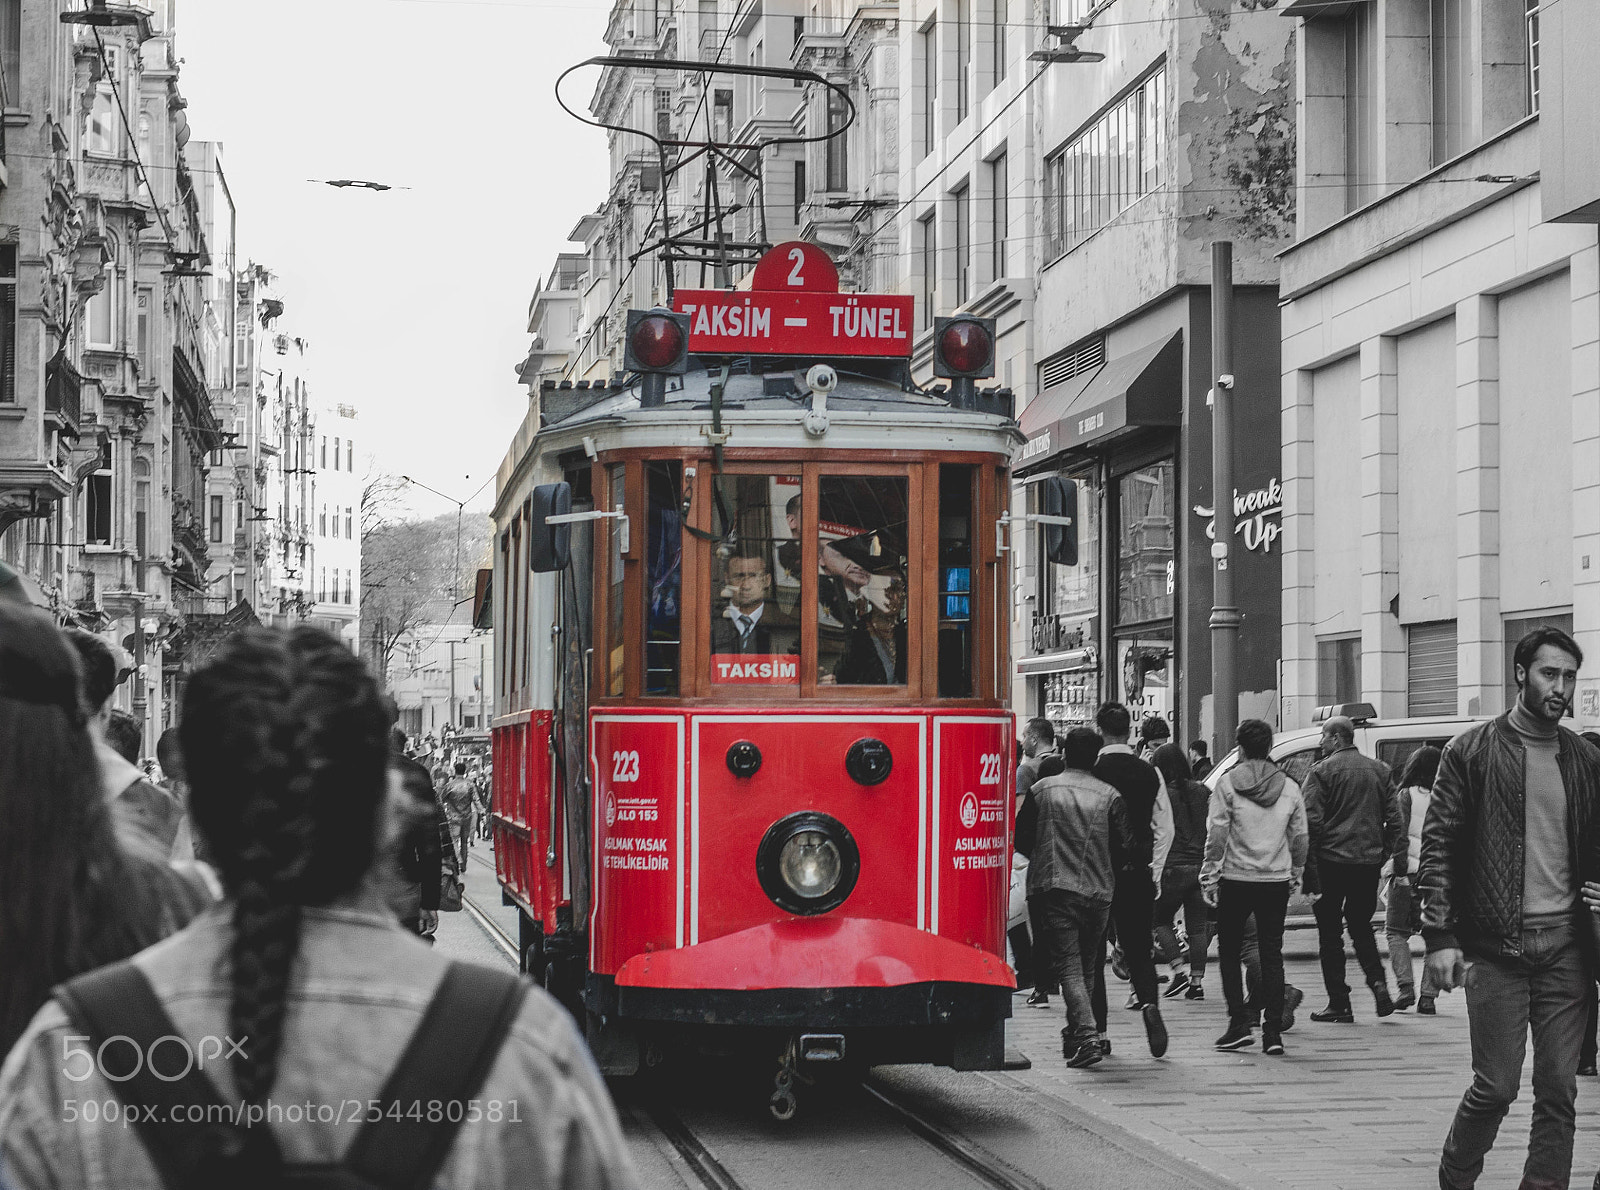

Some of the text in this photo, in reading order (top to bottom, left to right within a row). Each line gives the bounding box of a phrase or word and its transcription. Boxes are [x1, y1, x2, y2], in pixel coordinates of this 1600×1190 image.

[787, 248, 805, 286] 2
[682, 298, 771, 338] TAKSİM
[829, 298, 907, 339] TÜNEL
[717, 660, 797, 678] TAKSİM
[612, 750, 640, 782] 223
[980, 753, 1001, 785] 223
[617, 810, 636, 821] ALO
[638, 810, 658, 821] 153
[980, 811, 995, 822] ALO
[635, 838, 667, 852] YASAK
[955, 837, 991, 852] ASILMAK
[610, 853, 669, 871] TEHLİKELİDİR
[952, 856, 966, 870] VE
